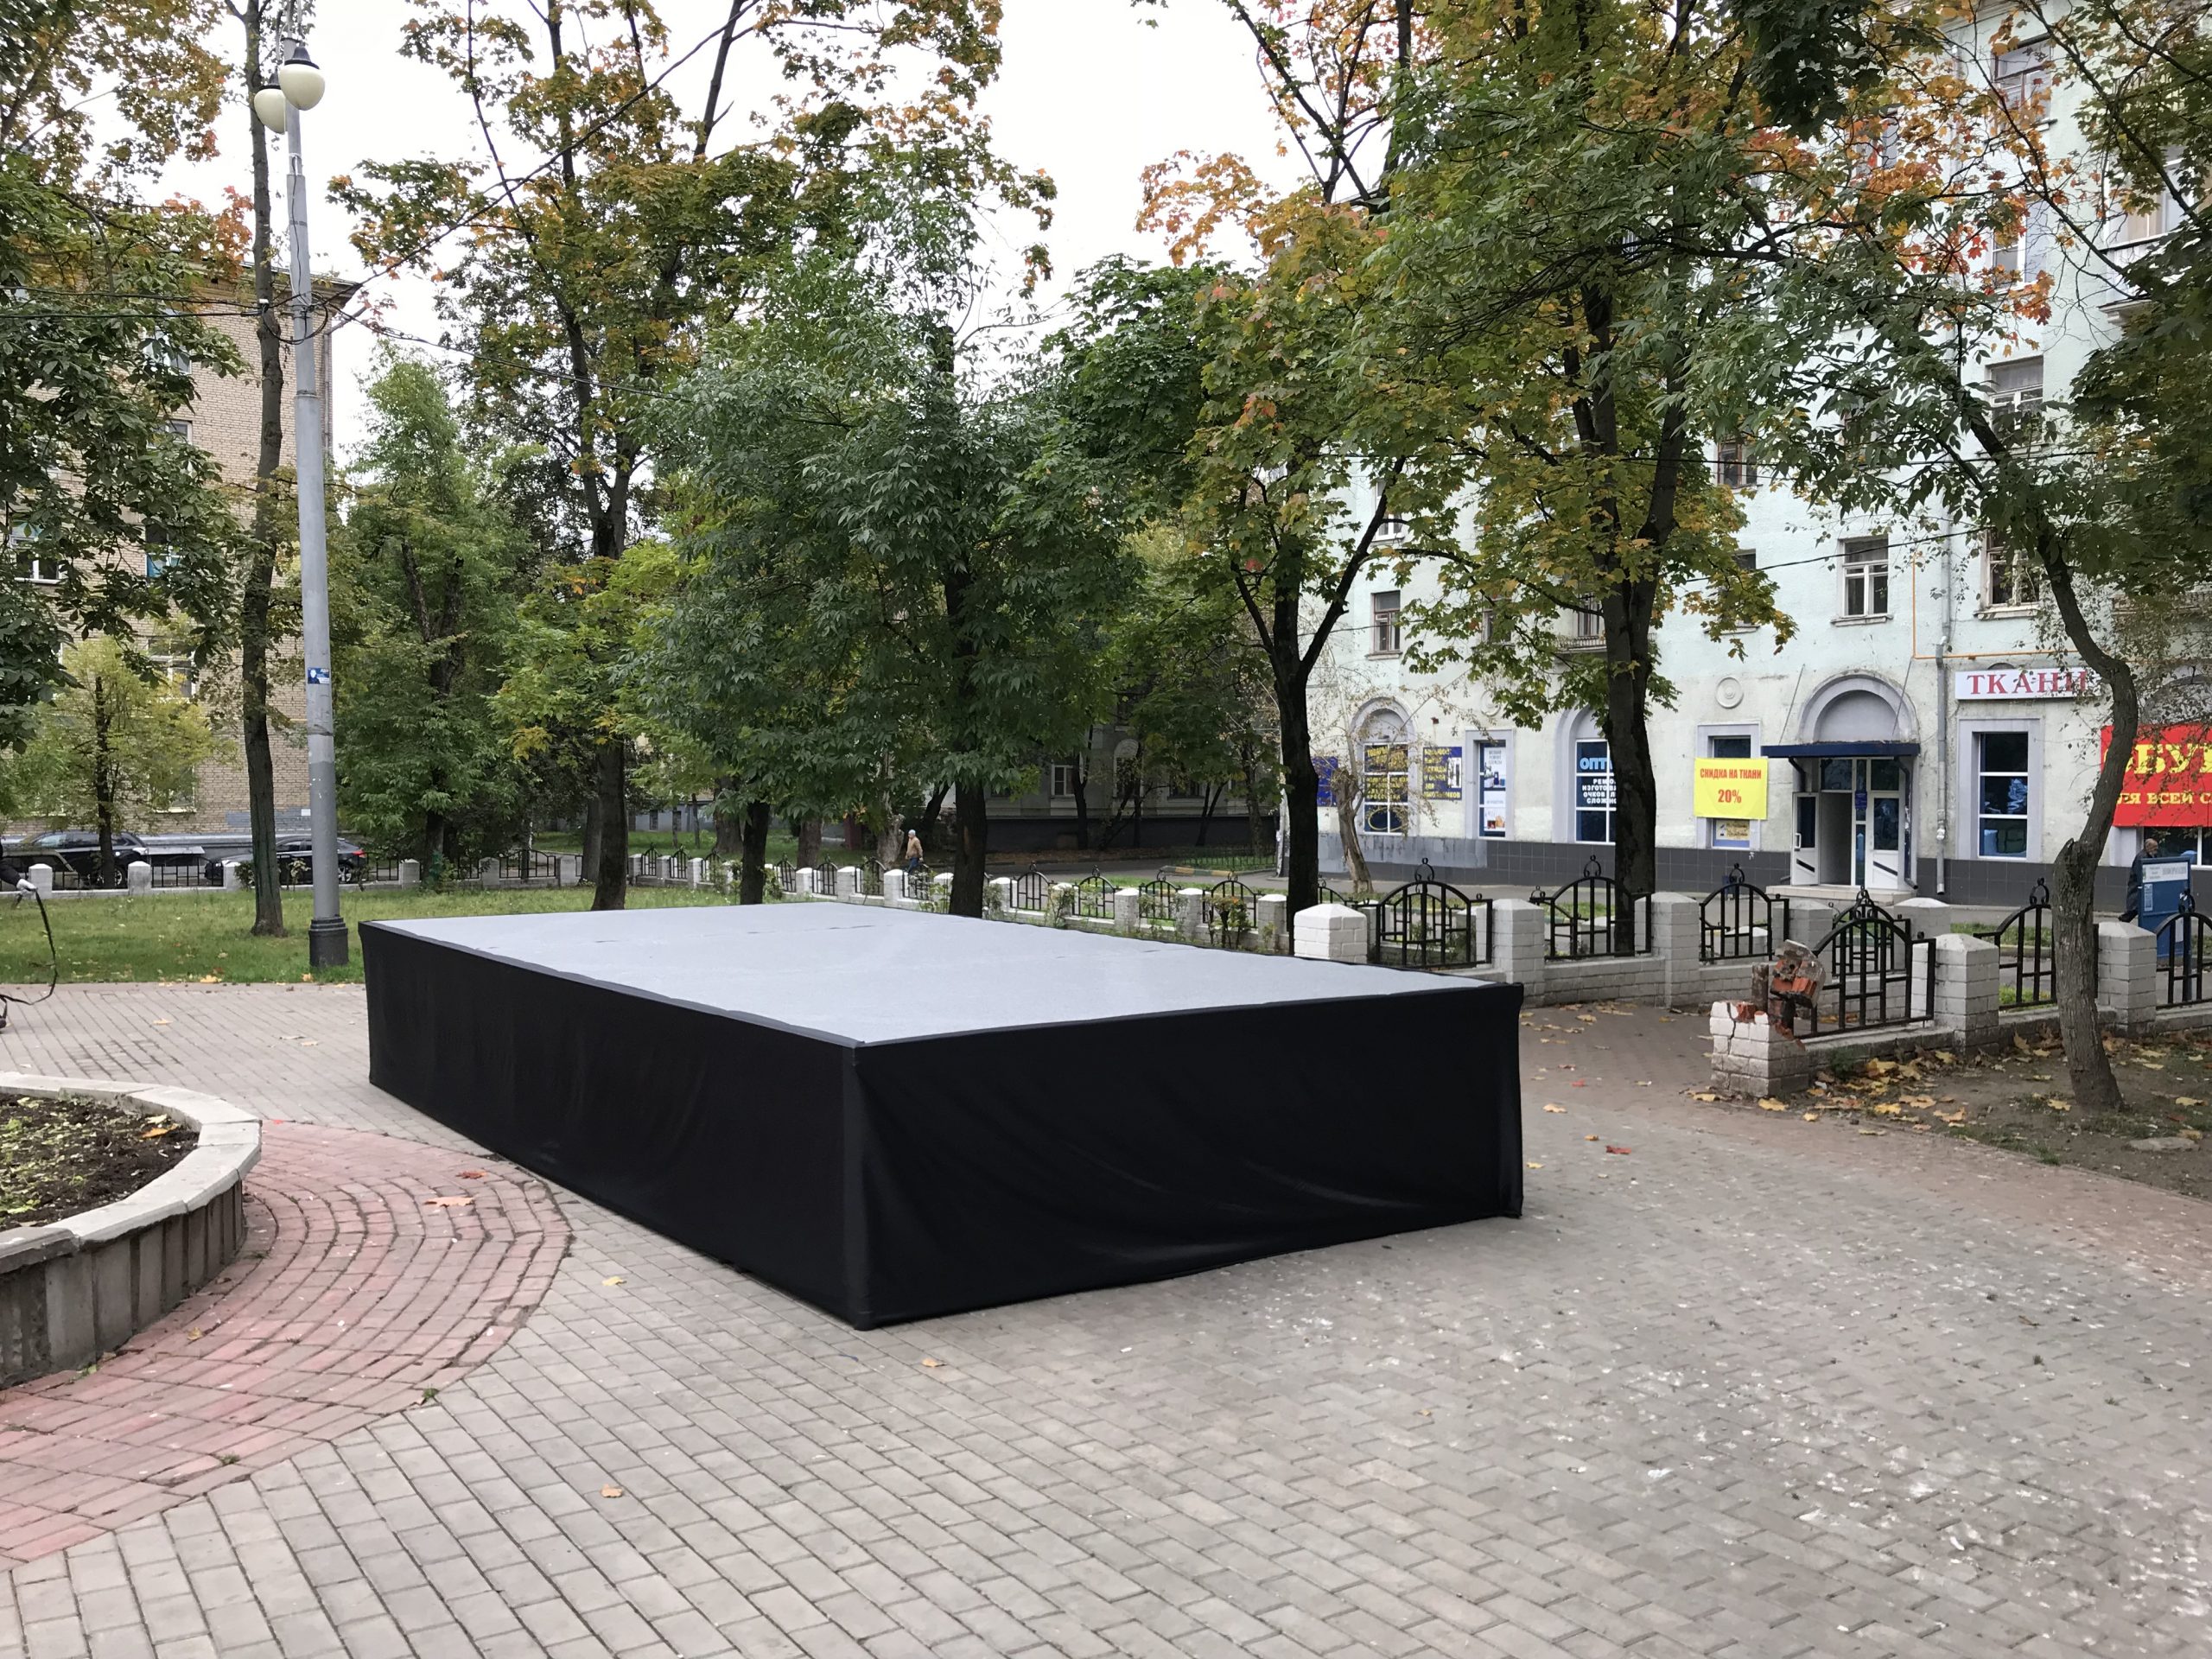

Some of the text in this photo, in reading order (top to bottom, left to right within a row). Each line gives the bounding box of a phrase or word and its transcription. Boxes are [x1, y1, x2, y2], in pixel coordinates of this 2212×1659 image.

[1967, 670, 2088, 694] ТКАНИ
[1700, 768, 1762, 779] СКИДКА НА ТКАНИ
[1718, 789, 1742, 804] 20%
[2146, 789, 2195, 804] ВСЕЙ
